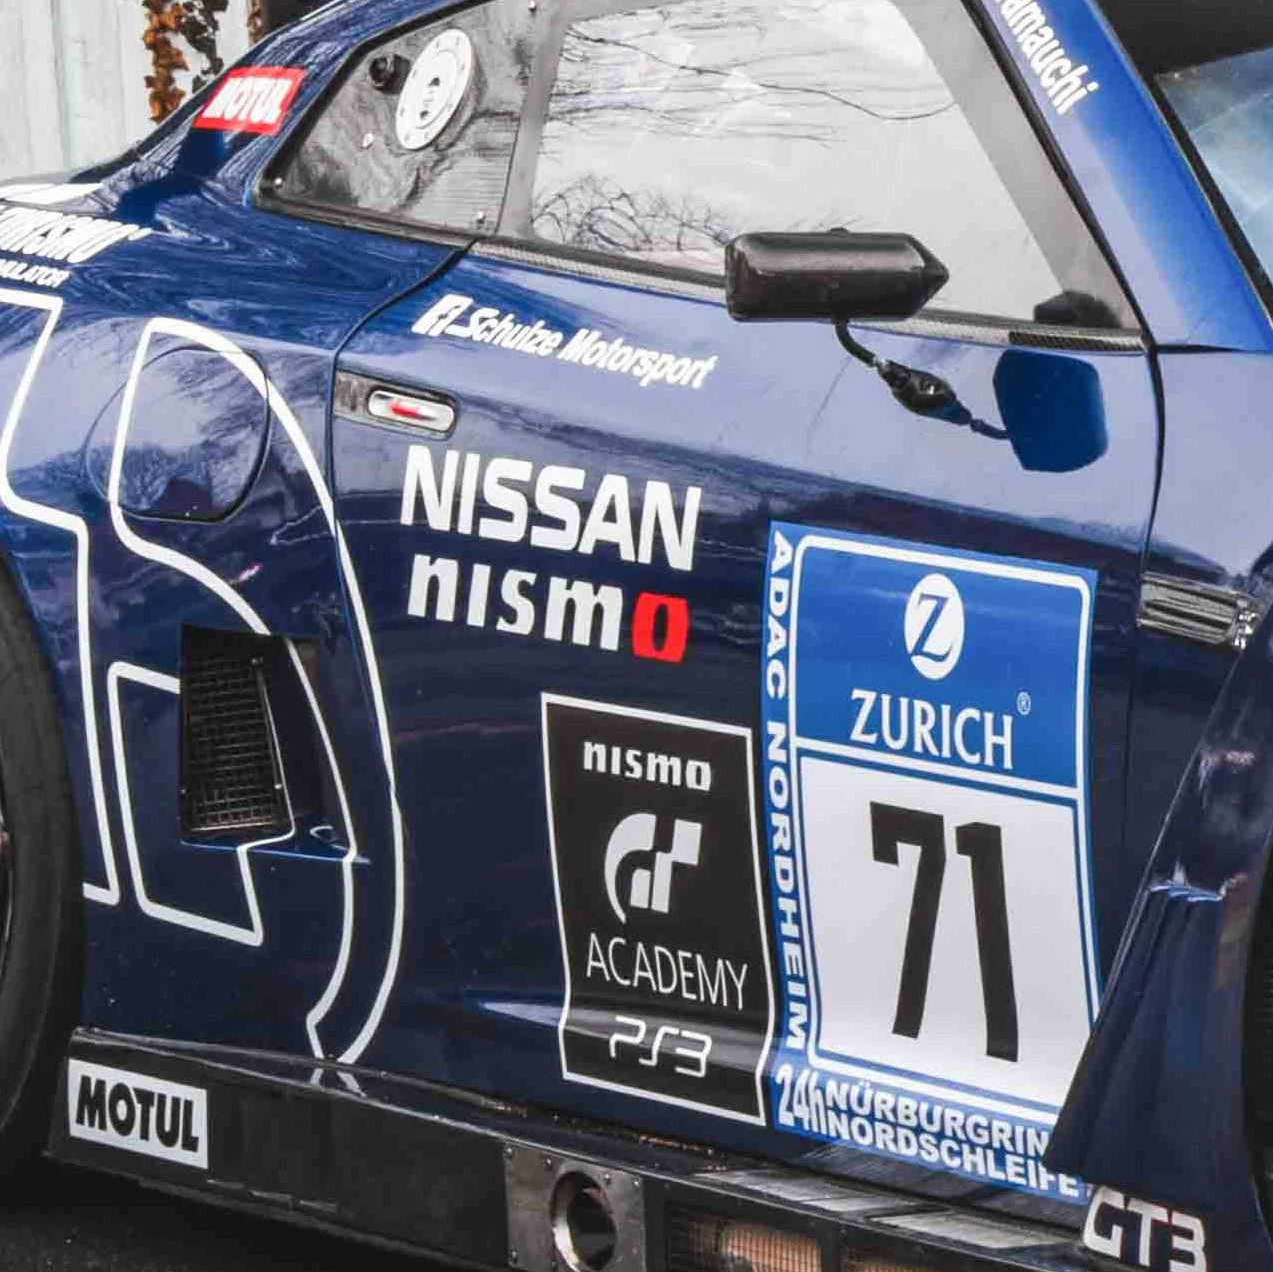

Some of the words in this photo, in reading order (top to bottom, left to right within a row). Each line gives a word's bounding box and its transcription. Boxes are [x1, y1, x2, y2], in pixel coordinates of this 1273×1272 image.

[201, 76, 294, 124] MOTUL
[557, 328, 718, 389] Motorsport
[400, 445, 702, 571] NISSAN
[407, 554, 692, 663] nismo
[766, 530, 794, 700] ADAC
[583, 740, 712, 792] nismo
[850, 688, 1014, 770] ZURICH
[766, 721, 808, 1050] NORDHEIM
[870, 801, 1019, 1062] 71
[586, 933, 748, 1011] ACADEMY
[609, 1015, 712, 1078] PS3
[76, 1074, 200, 1153] MOTUL
